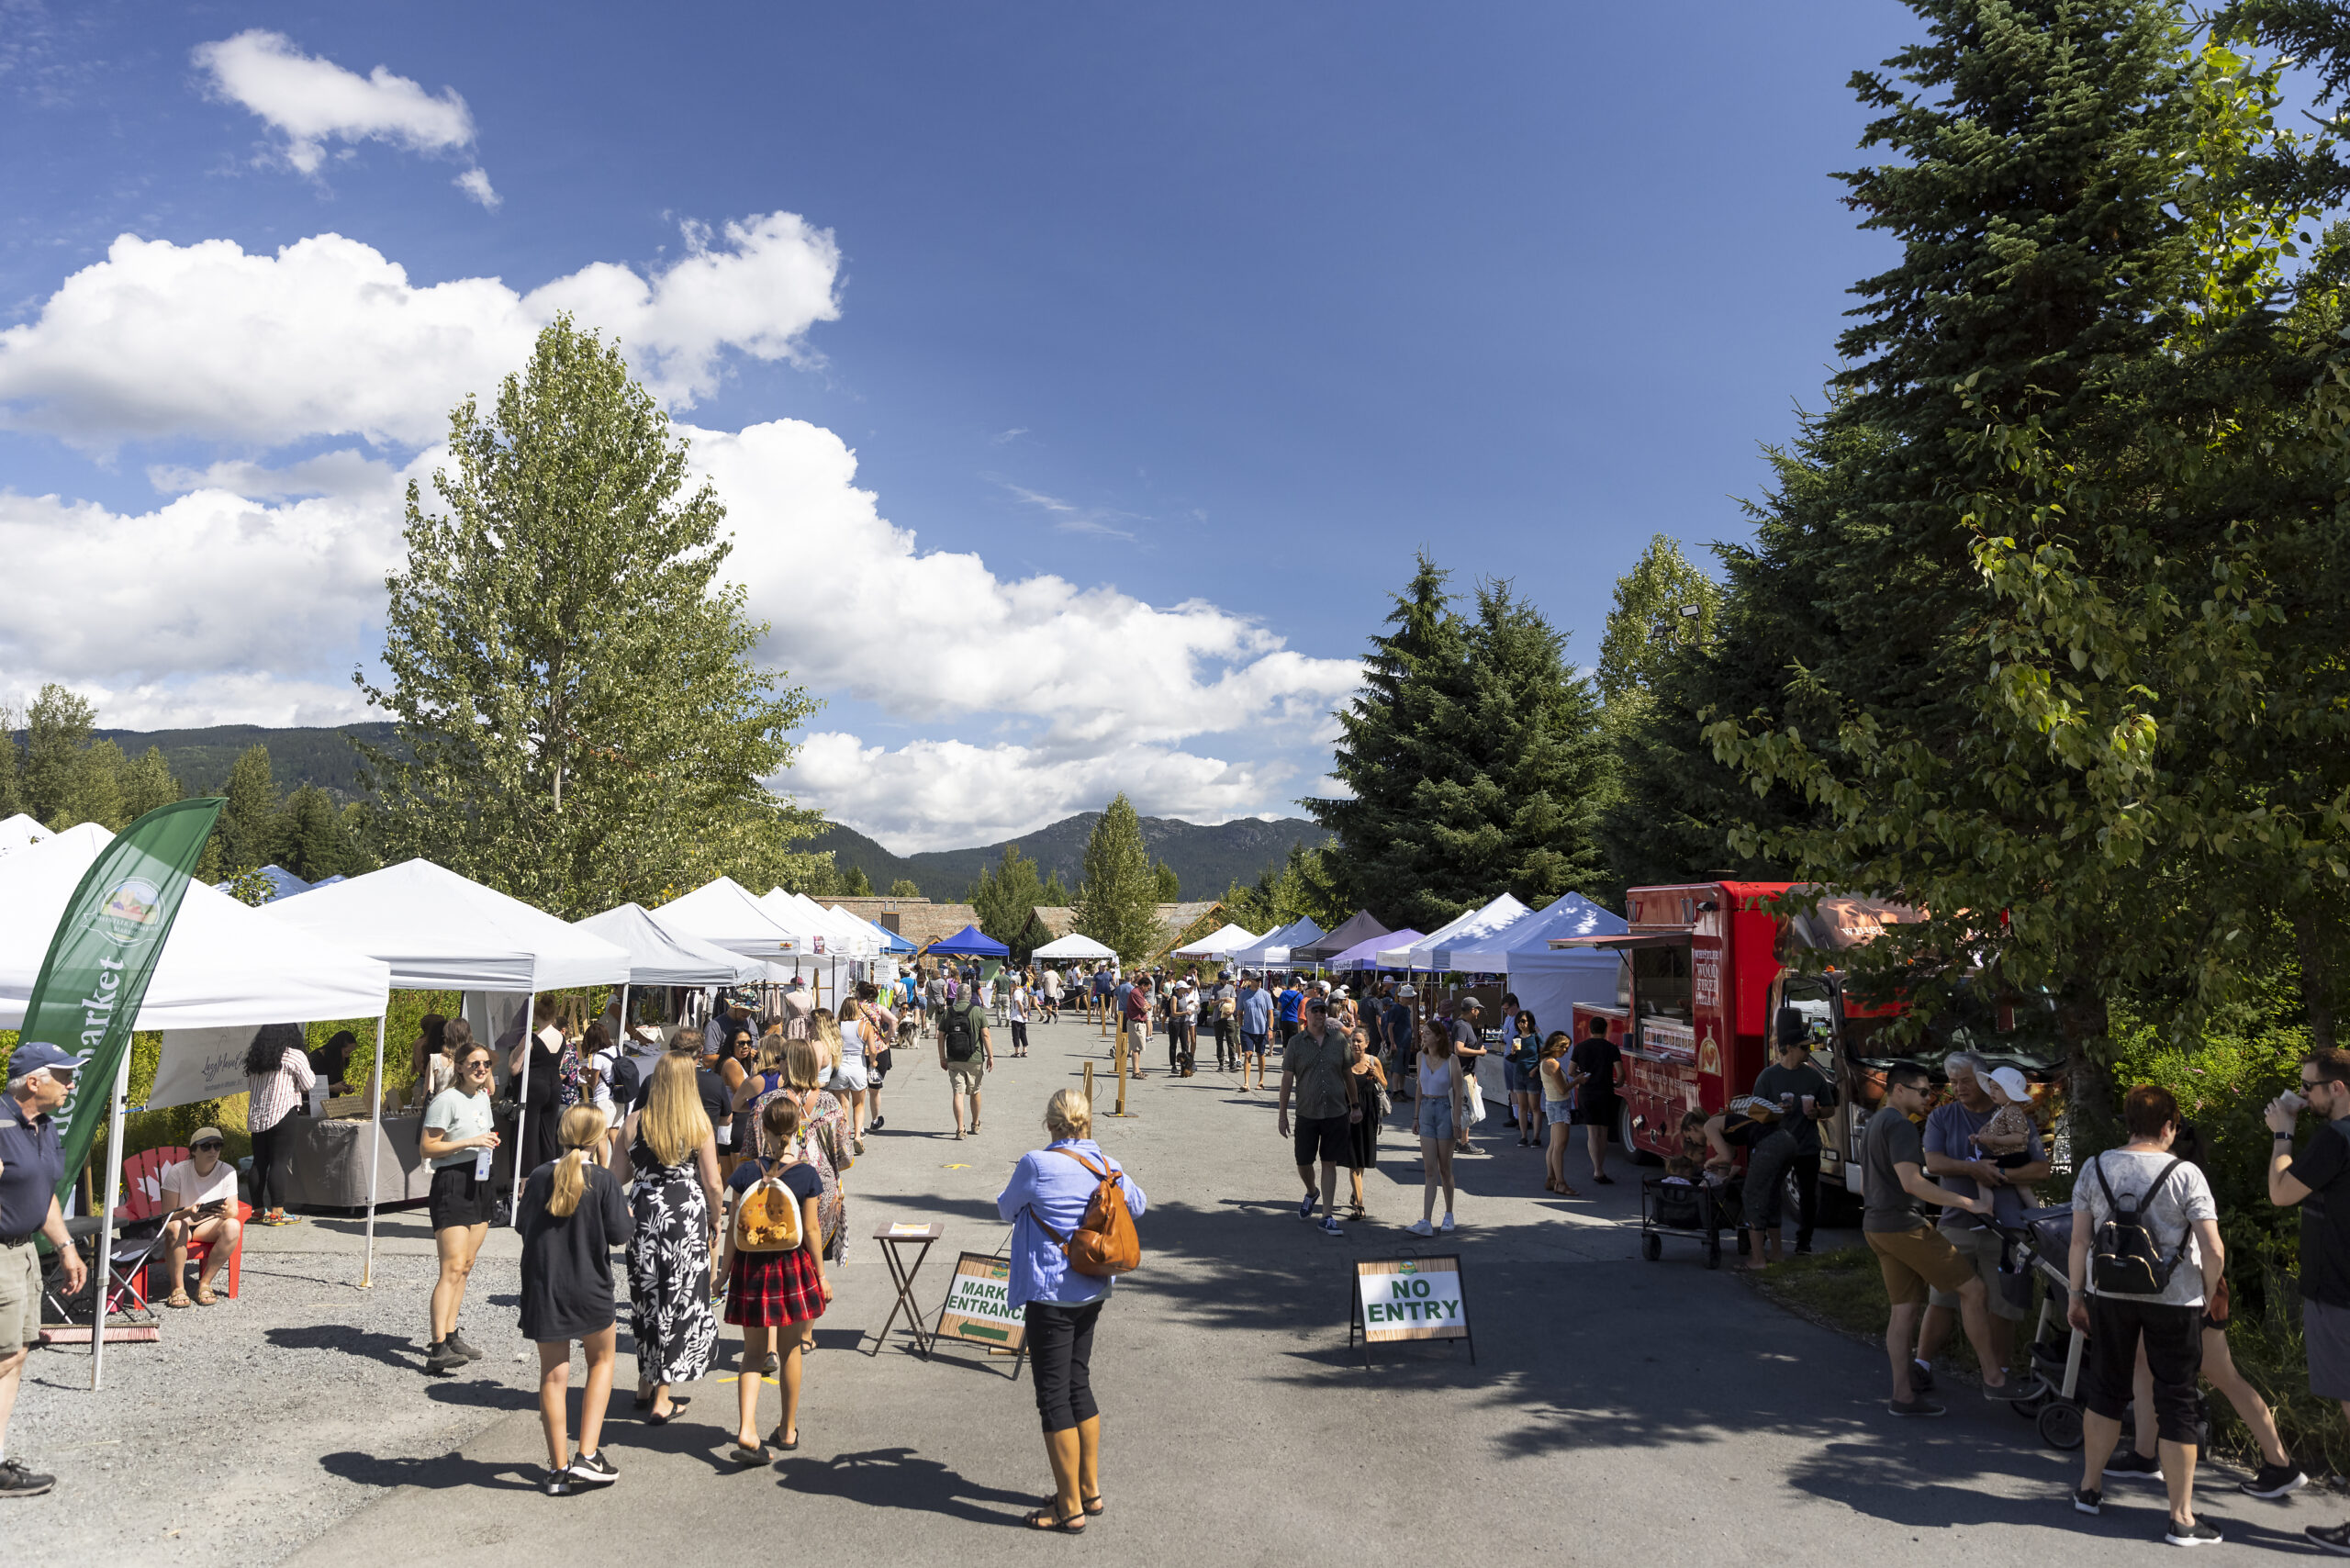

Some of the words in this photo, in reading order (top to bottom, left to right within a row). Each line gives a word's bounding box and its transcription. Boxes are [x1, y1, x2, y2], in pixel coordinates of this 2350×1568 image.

[1841, 925, 1886, 936] WHIST
[1696, 964, 1718, 978] WOOD
[1696, 979, 1719, 992] FIRED
[961, 1281, 1008, 1302] MARK
[1392, 1279, 1430, 1299] NO
[1368, 1300, 1459, 1323] ENTRY
